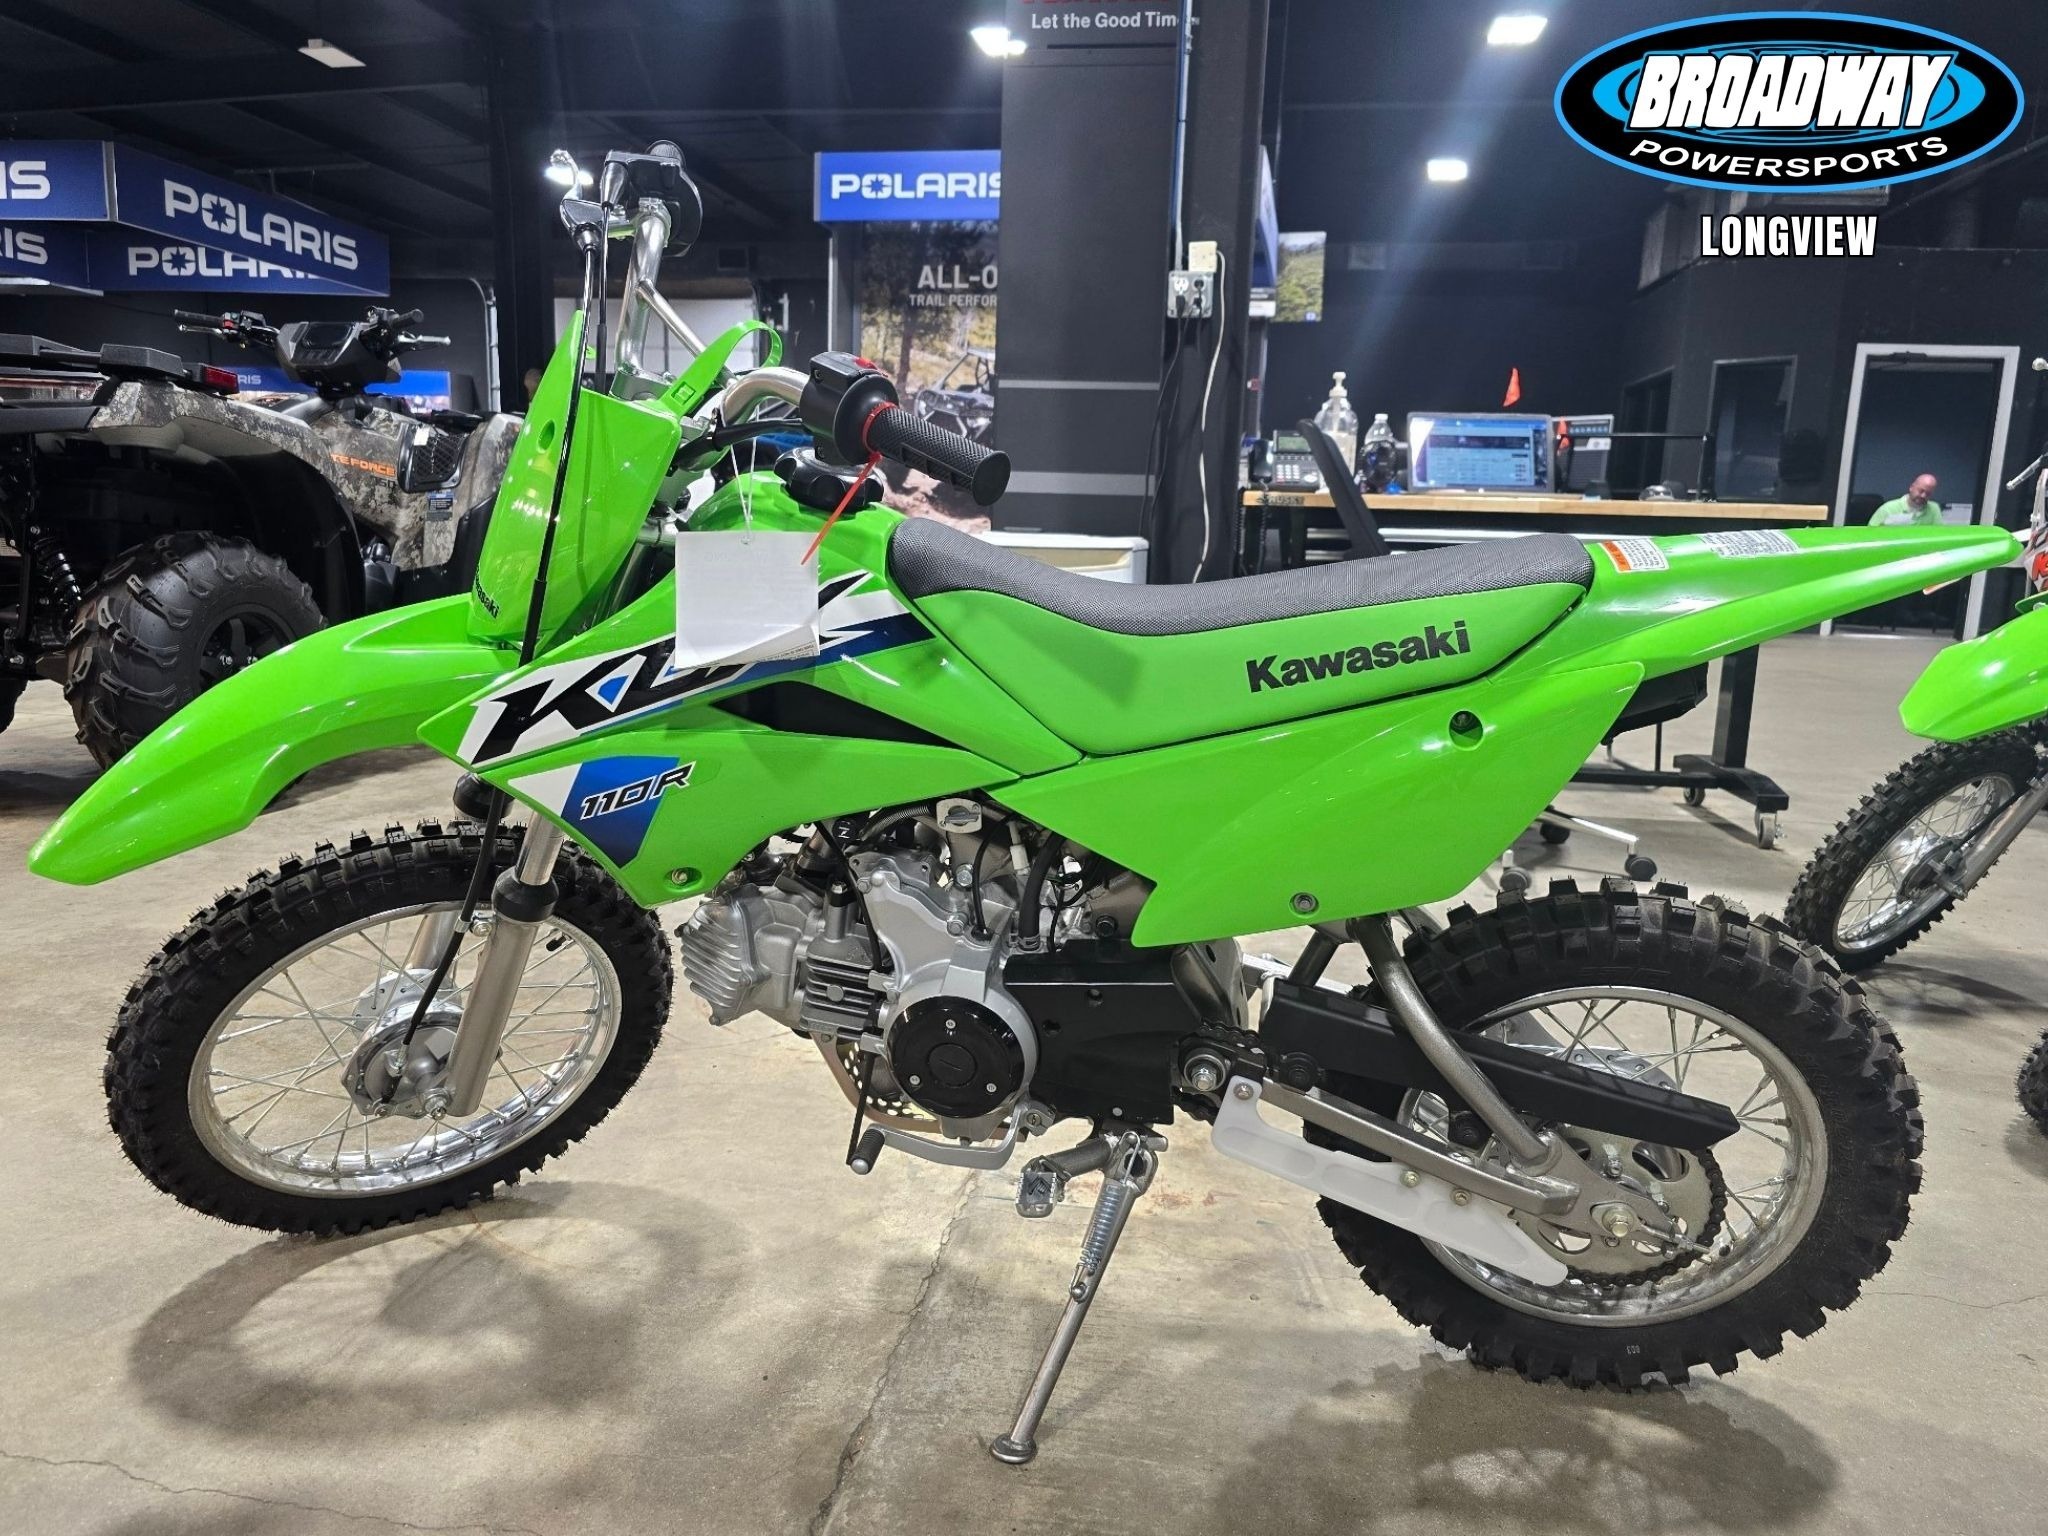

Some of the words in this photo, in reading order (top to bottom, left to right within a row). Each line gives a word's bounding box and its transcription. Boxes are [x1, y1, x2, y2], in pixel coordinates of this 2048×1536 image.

[1032, 13, 1058, 29] Let
[1063, 13, 1091, 28] the
[1095, 12, 1141, 28] Good
[163, 178, 359, 271] POLARIS
[0, 227, 49, 265] IS
[917, 264, 998, 289] ALL-O
[909, 294, 945, 307] TRAIL
[950, 294, 997, 307] PERFOR
[350, 458, 396, 475] FORCE
[1246, 620, 1471, 693] Kawasaki
[580, 761, 696, 820] 110R
